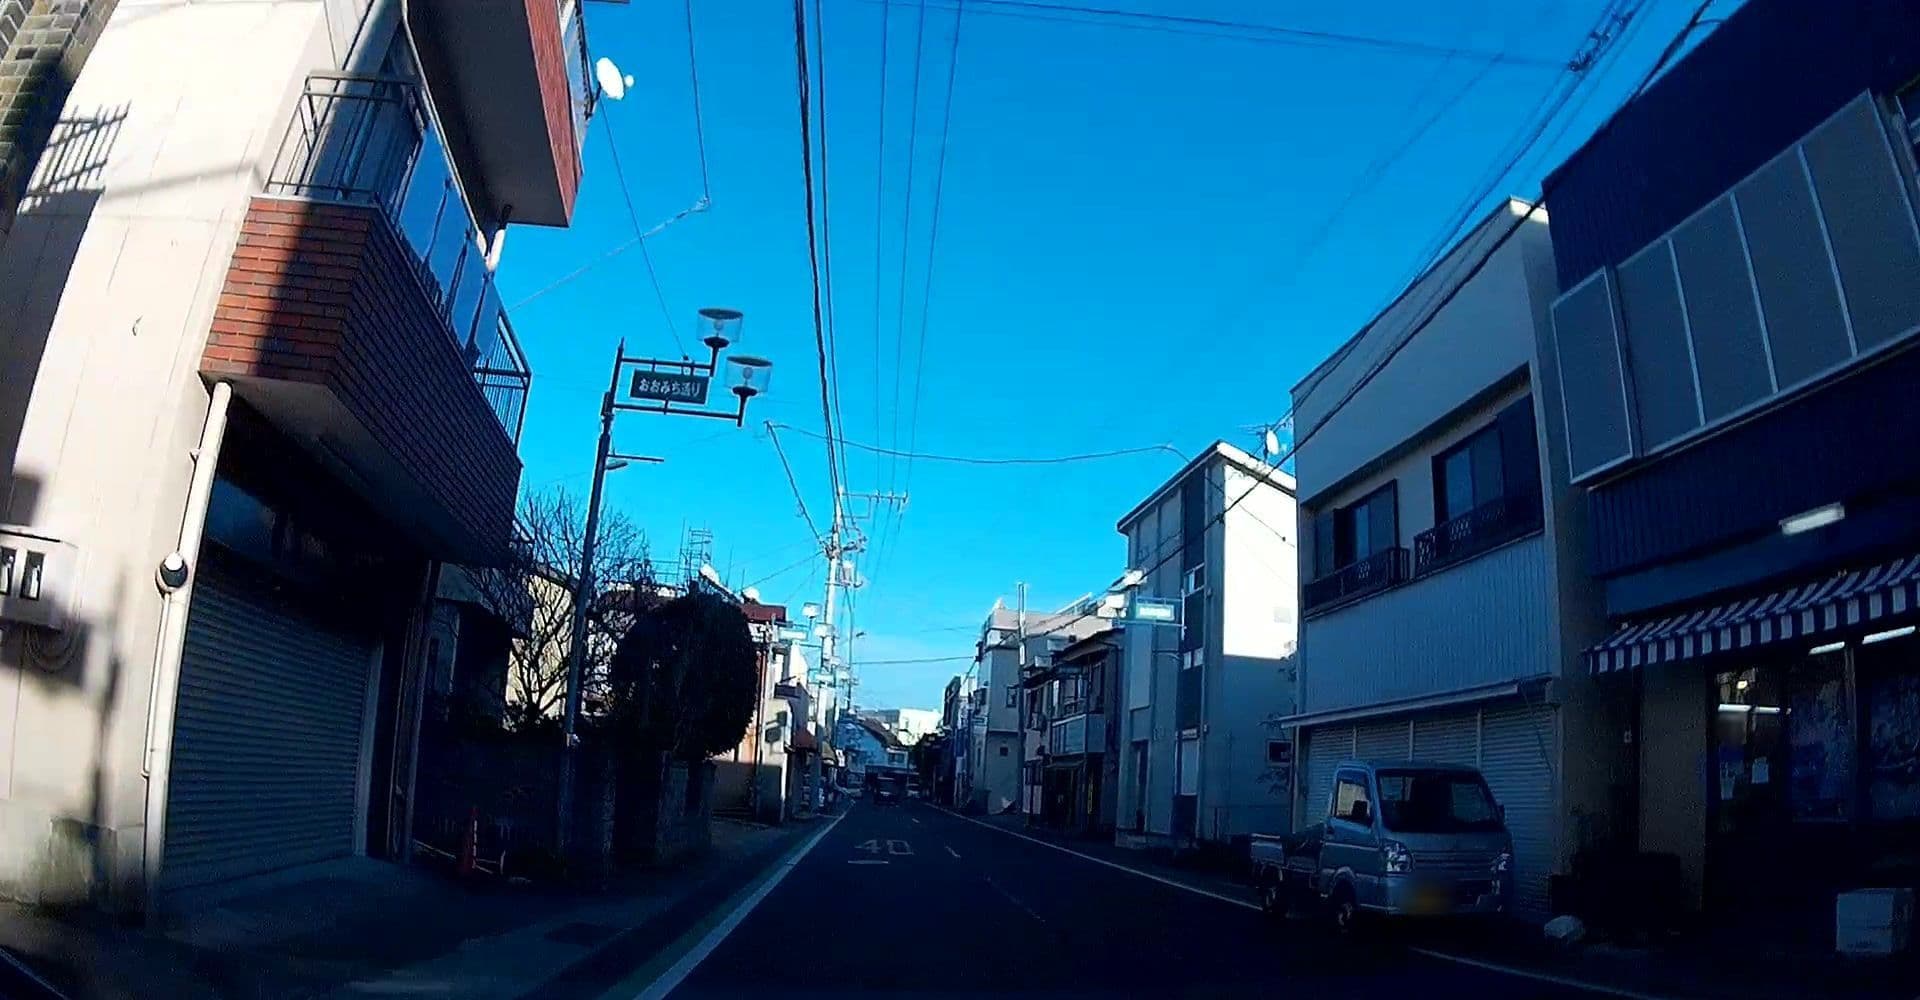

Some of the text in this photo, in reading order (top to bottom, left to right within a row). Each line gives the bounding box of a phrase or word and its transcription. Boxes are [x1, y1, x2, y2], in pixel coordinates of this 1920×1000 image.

[639, 378, 701, 397] おおみち通り
[855, 839, 914, 855] 40
